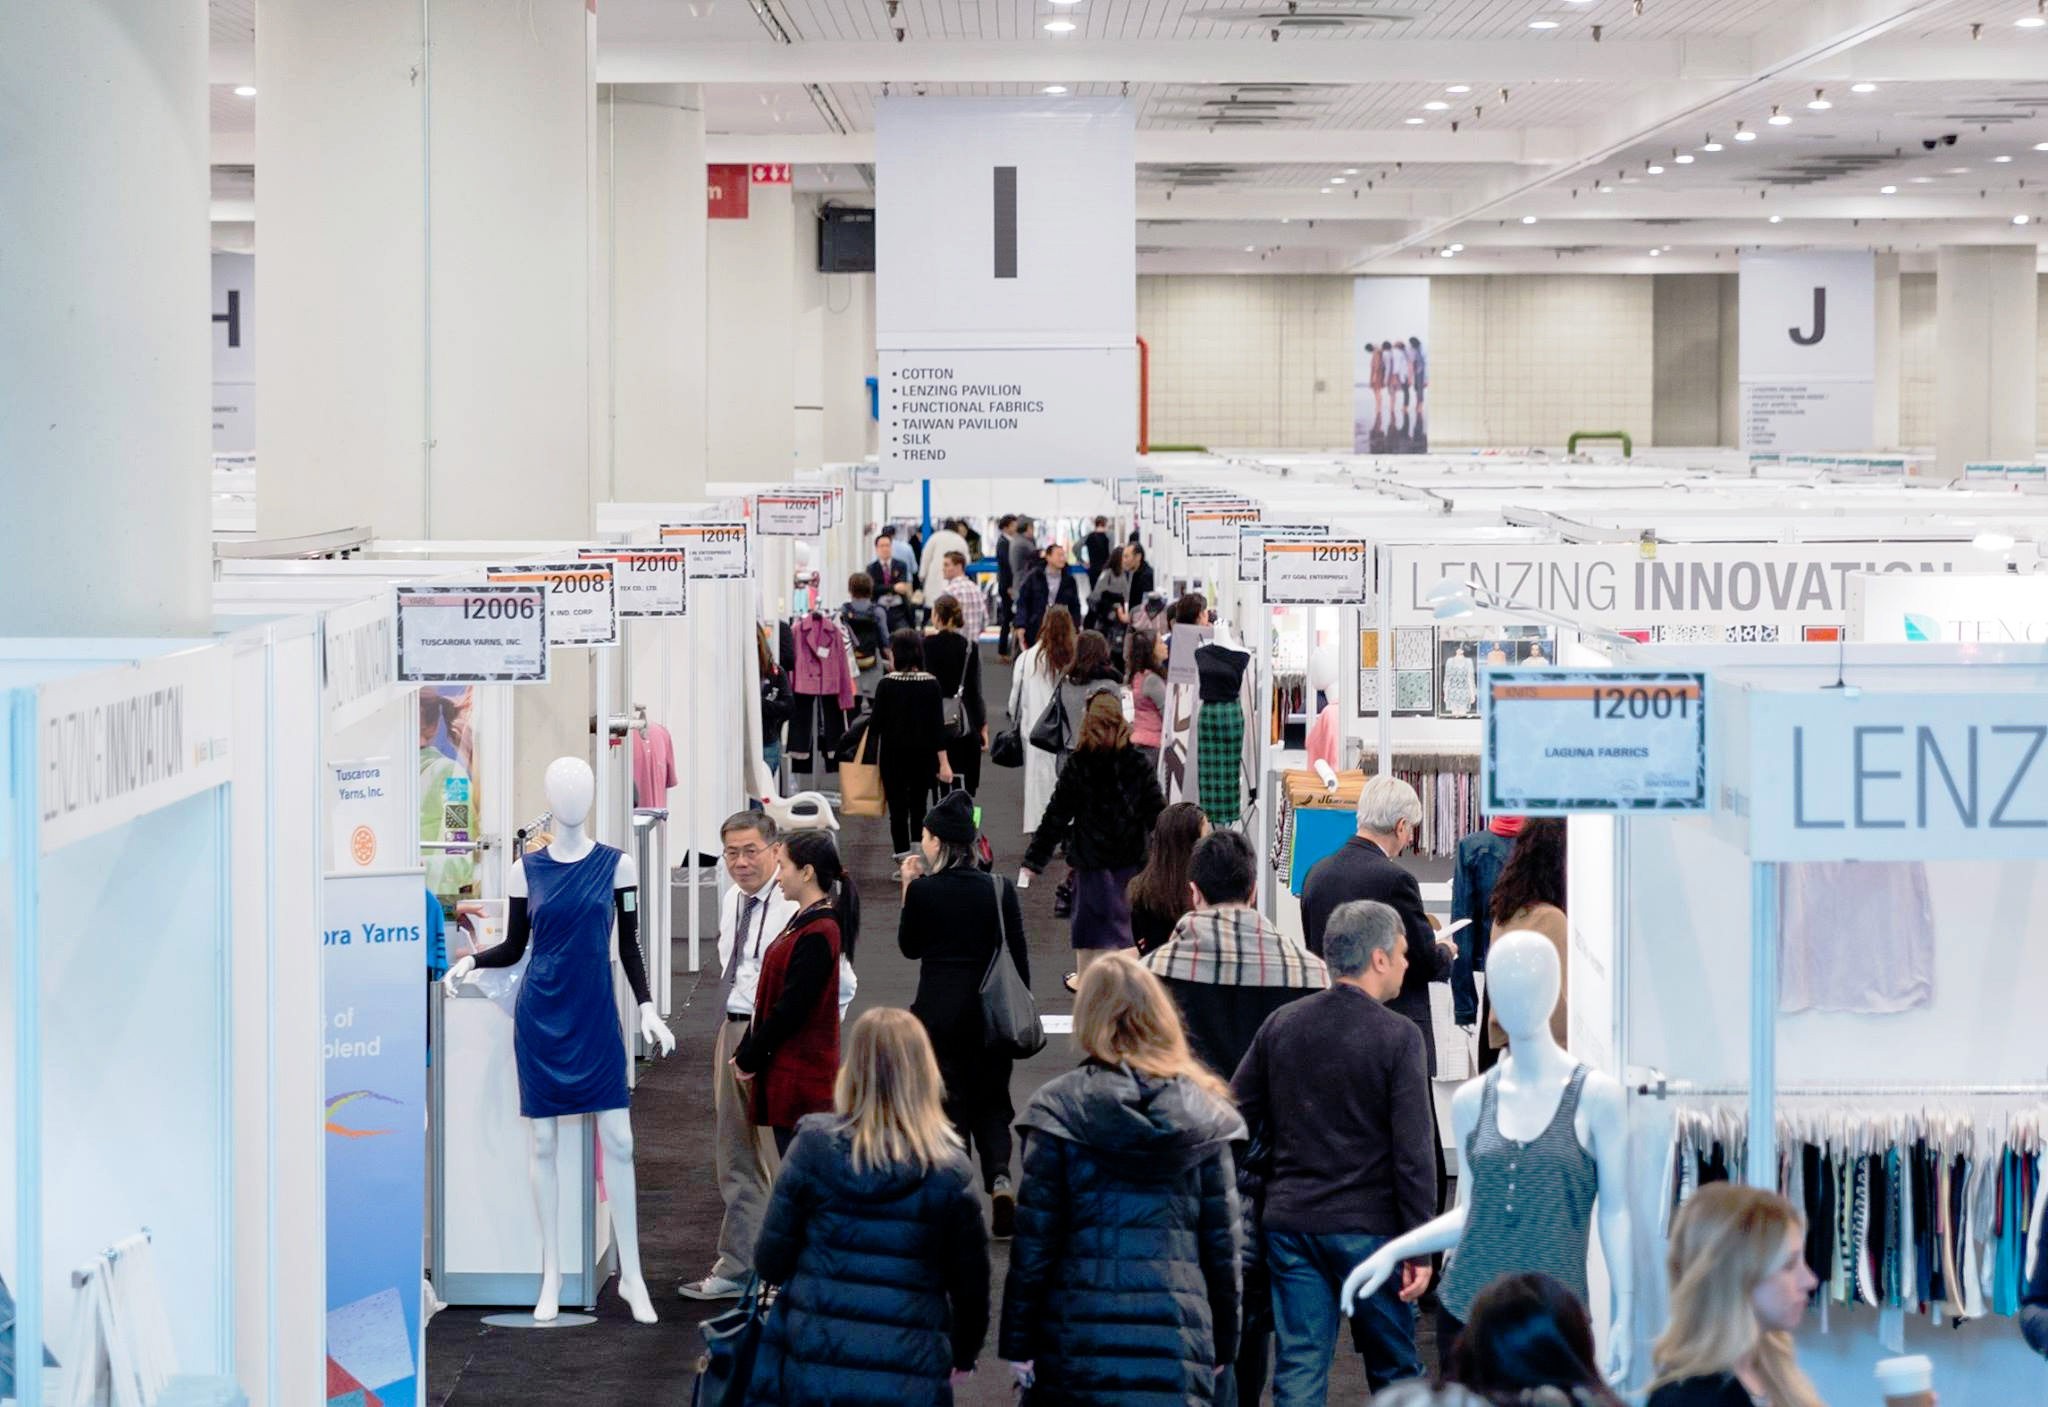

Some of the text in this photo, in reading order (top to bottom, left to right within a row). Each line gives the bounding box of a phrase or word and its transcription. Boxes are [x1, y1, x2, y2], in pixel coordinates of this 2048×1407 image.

[1789, 287, 1826, 346] J
[901, 368, 953, 380] COTTON
[901, 384, 1022, 397] LENZING PAVILION
[902, 401, 1044, 414] FUNCTIONAL FABRICS
[902, 418, 1018, 430] TAIWAN PAVILION
[902, 433, 931, 445] SILK
[903, 449, 946, 461] TREND
[702, 529, 741, 543] I2014
[1313, 546, 1359, 562] I2013
[630, 555, 677, 572] I2010
[544, 574, 604, 594] 2008
[1634, 561, 1952, 611] INNOVAT
[464, 598, 535, 619] I2006
[473, 639, 503, 647] YARNS,
[1593, 687, 1688, 719] I2001
[1545, 747, 1649, 758] LAGUNA FABRICS
[336, 768, 381, 782] Tuscarora
[1793, 725, 2048, 829] LENZ
[339, 786, 384, 800] Yarns, Inc.
[361, 923, 420, 944] Yarns
[334, 1007, 354, 1028] of
